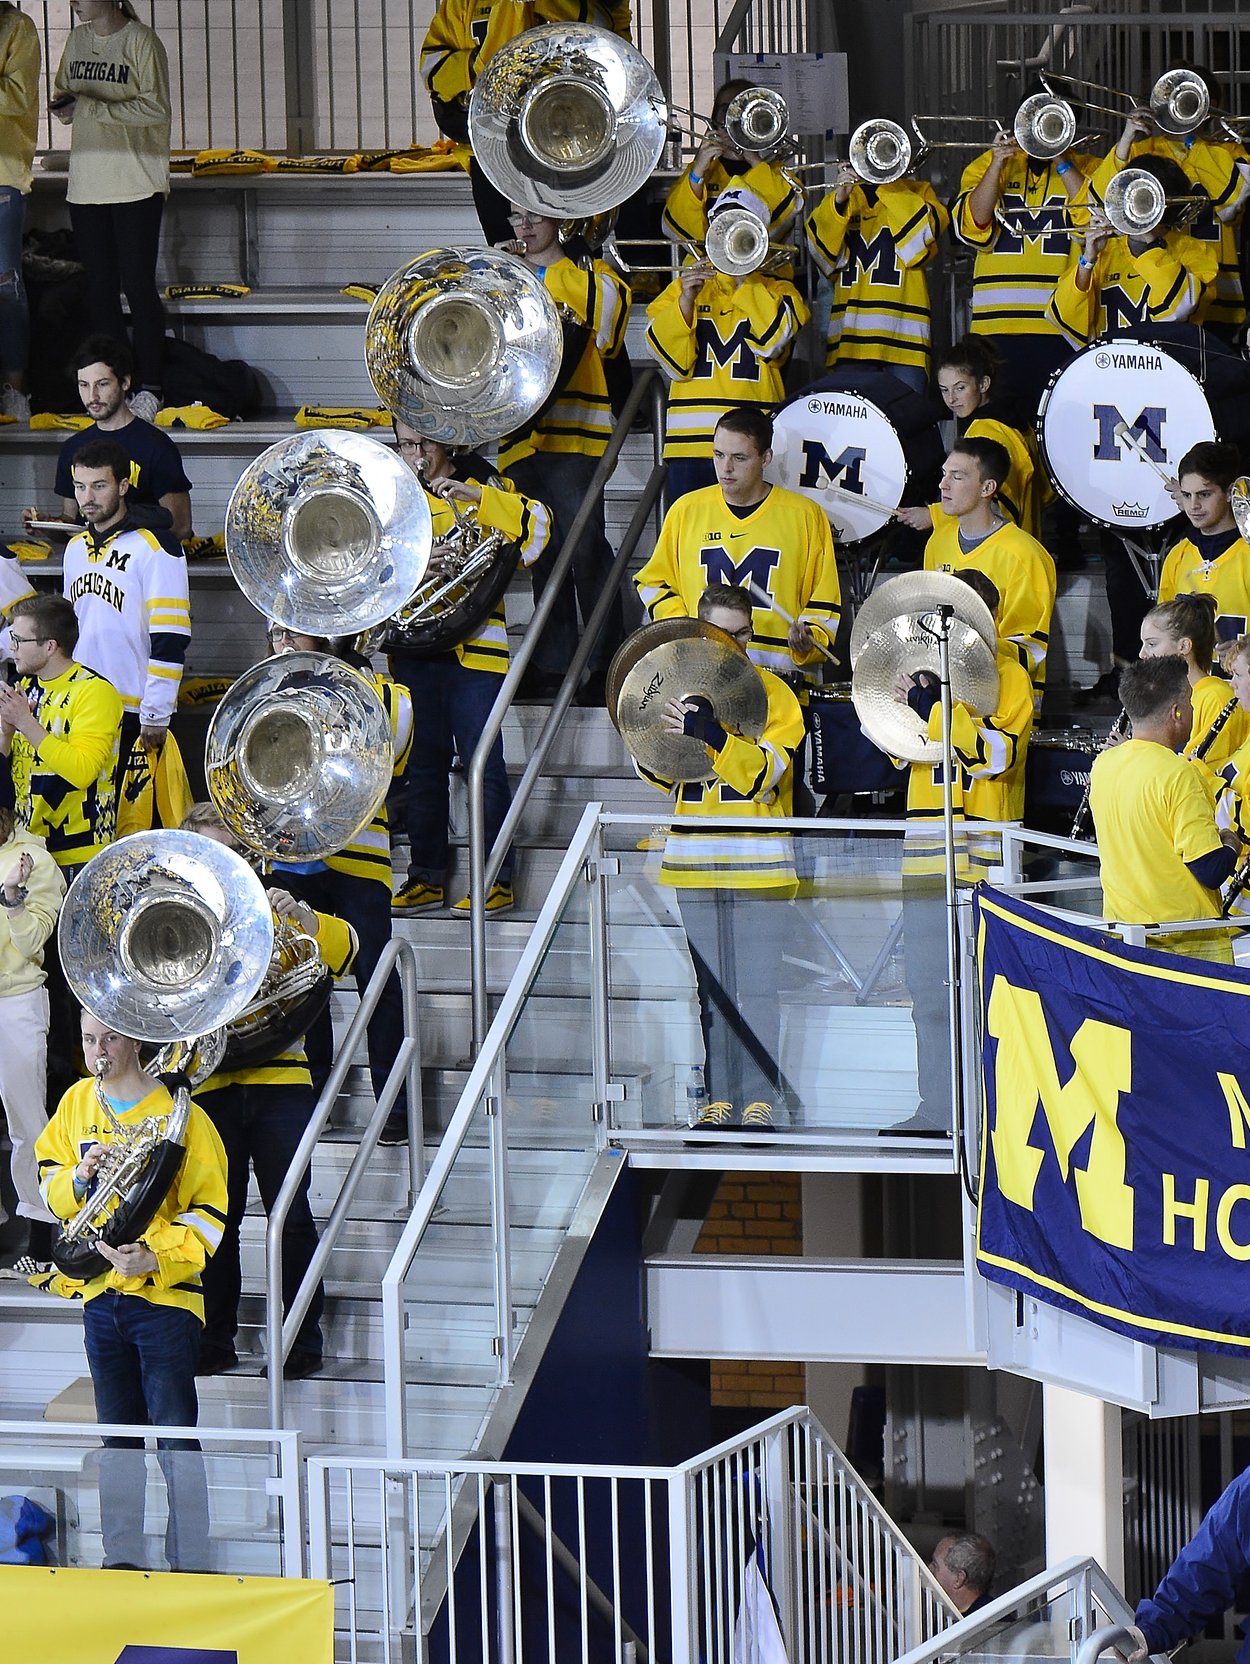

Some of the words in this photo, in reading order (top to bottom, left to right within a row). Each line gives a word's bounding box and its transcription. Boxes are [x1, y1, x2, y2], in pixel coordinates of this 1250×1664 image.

[992, 193, 1071, 256] M
[840, 226, 903, 288] M
[692, 317, 761, 382] M
[1112, 354, 1162, 370] YAMAHA
[822, 401, 868, 419] YAMAHA
[1092, 403, 1168, 464] M
[799, 439, 868, 496] M
[1117, 509, 1145, 517] REMO
[105, 549, 132, 572] M
[814, 729, 826, 783] YAMAHA
[27, 787, 92, 837] M
[987, 973, 1134, 1252] M
